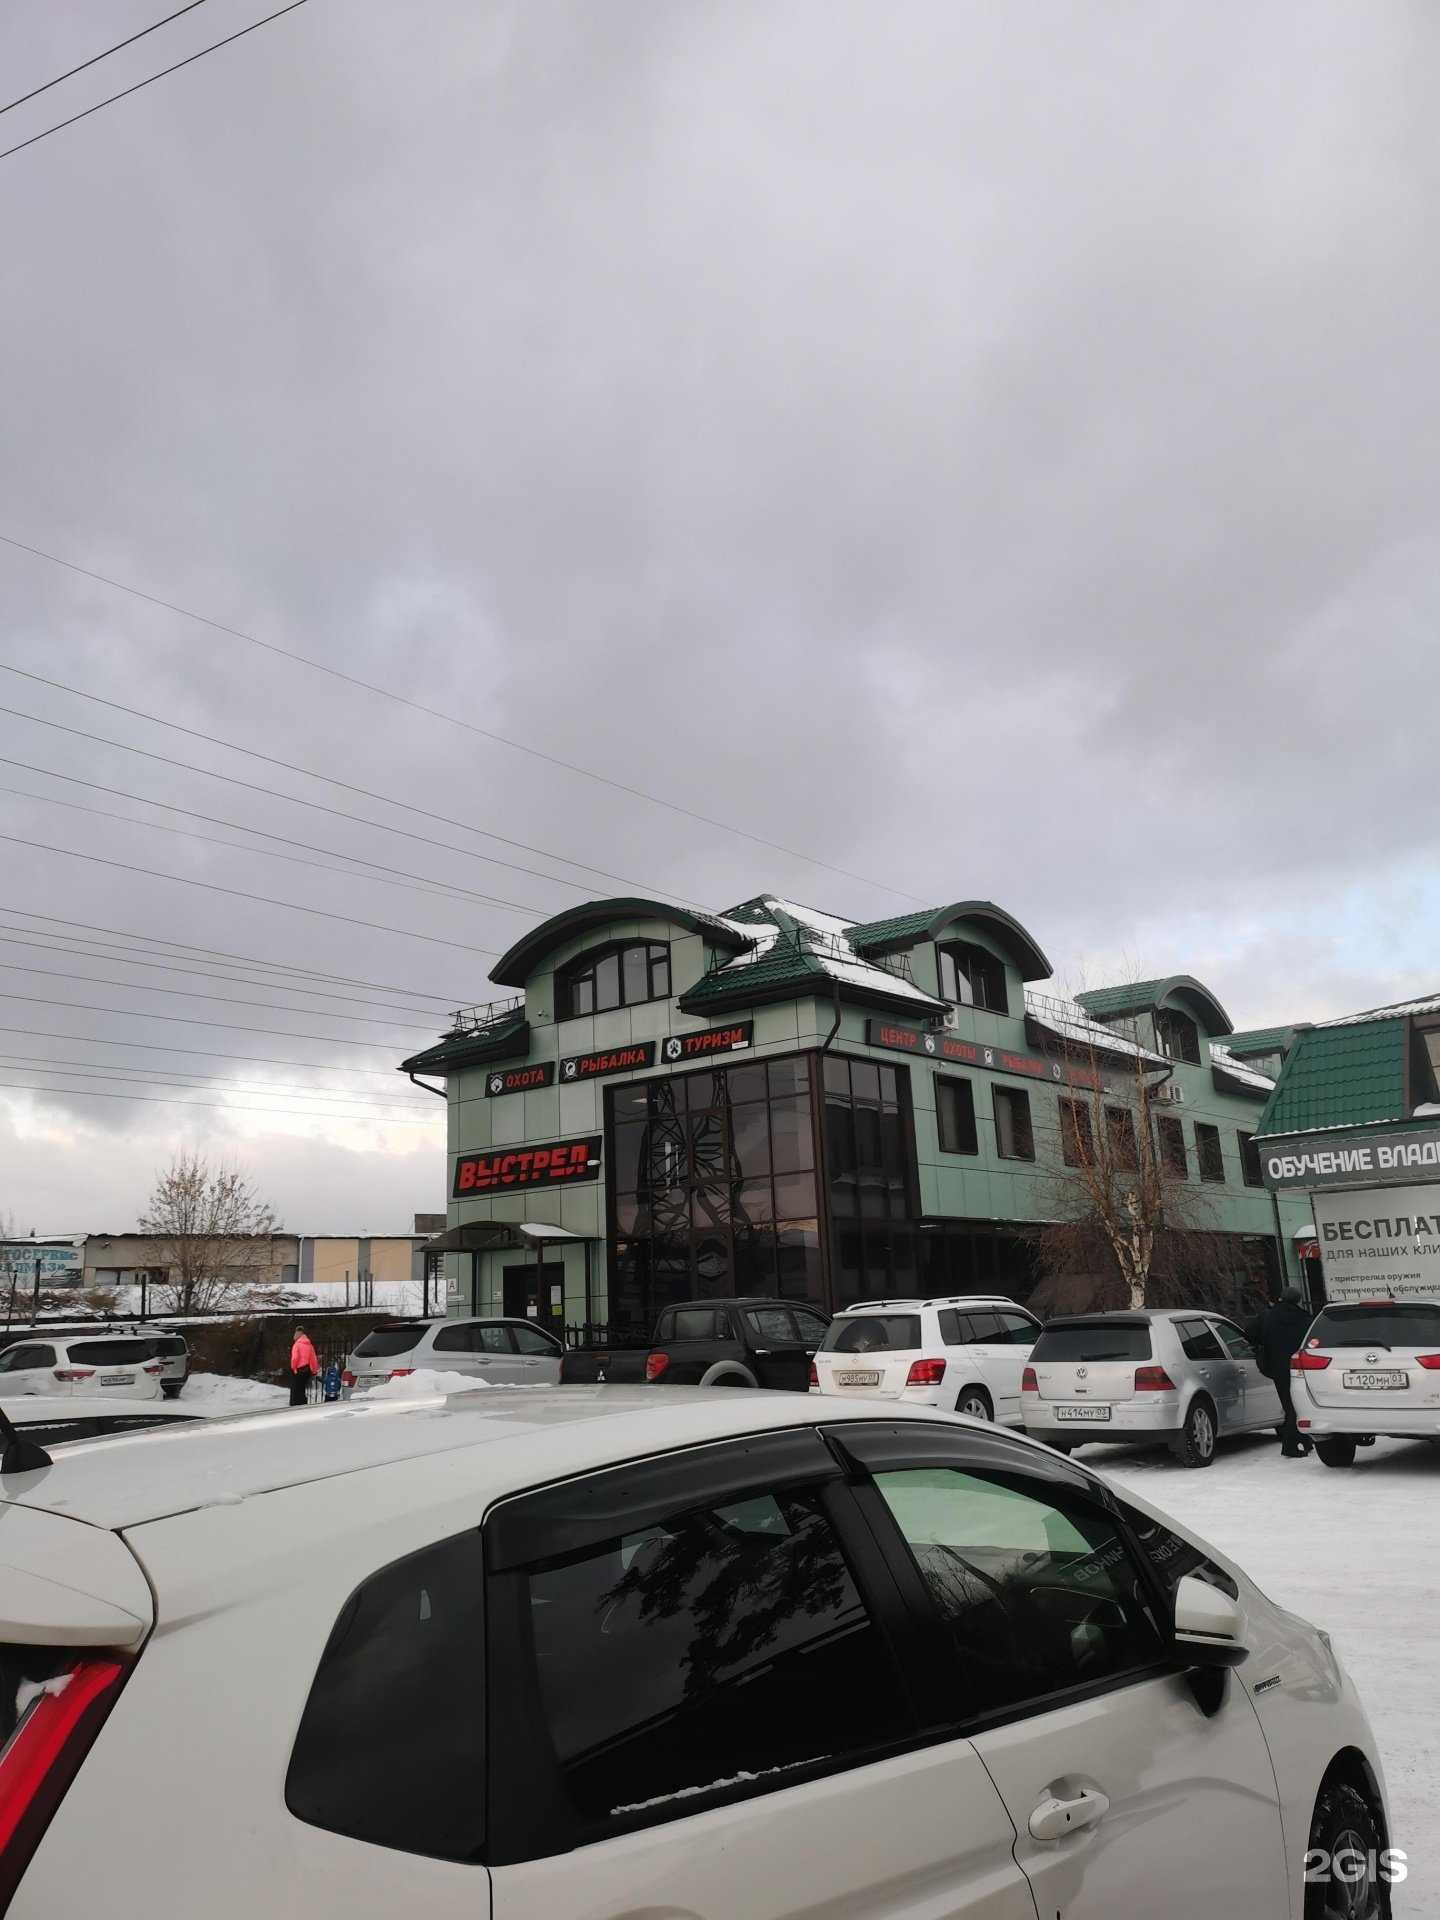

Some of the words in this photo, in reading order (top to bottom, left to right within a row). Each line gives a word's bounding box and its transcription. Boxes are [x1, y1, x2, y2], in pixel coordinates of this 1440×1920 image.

[686, 1028, 743, 1052] ТУРИЗМ
[880, 1027, 918, 1048] ЦЕНТР
[580, 1048, 647, 1074] РЫБАЛКА
[506, 1069, 545, 1089] ОХОТА
[458, 1144, 589, 1190] ВЫСТРЕЛ
[1267, 1148, 1374, 1180] ОБУЧЕНИЕ
[1376, 1141, 1440, 1170] ВЛАД
[1327, 1248, 1354, 1262] для
[1358, 1245, 1409, 1259] наших
